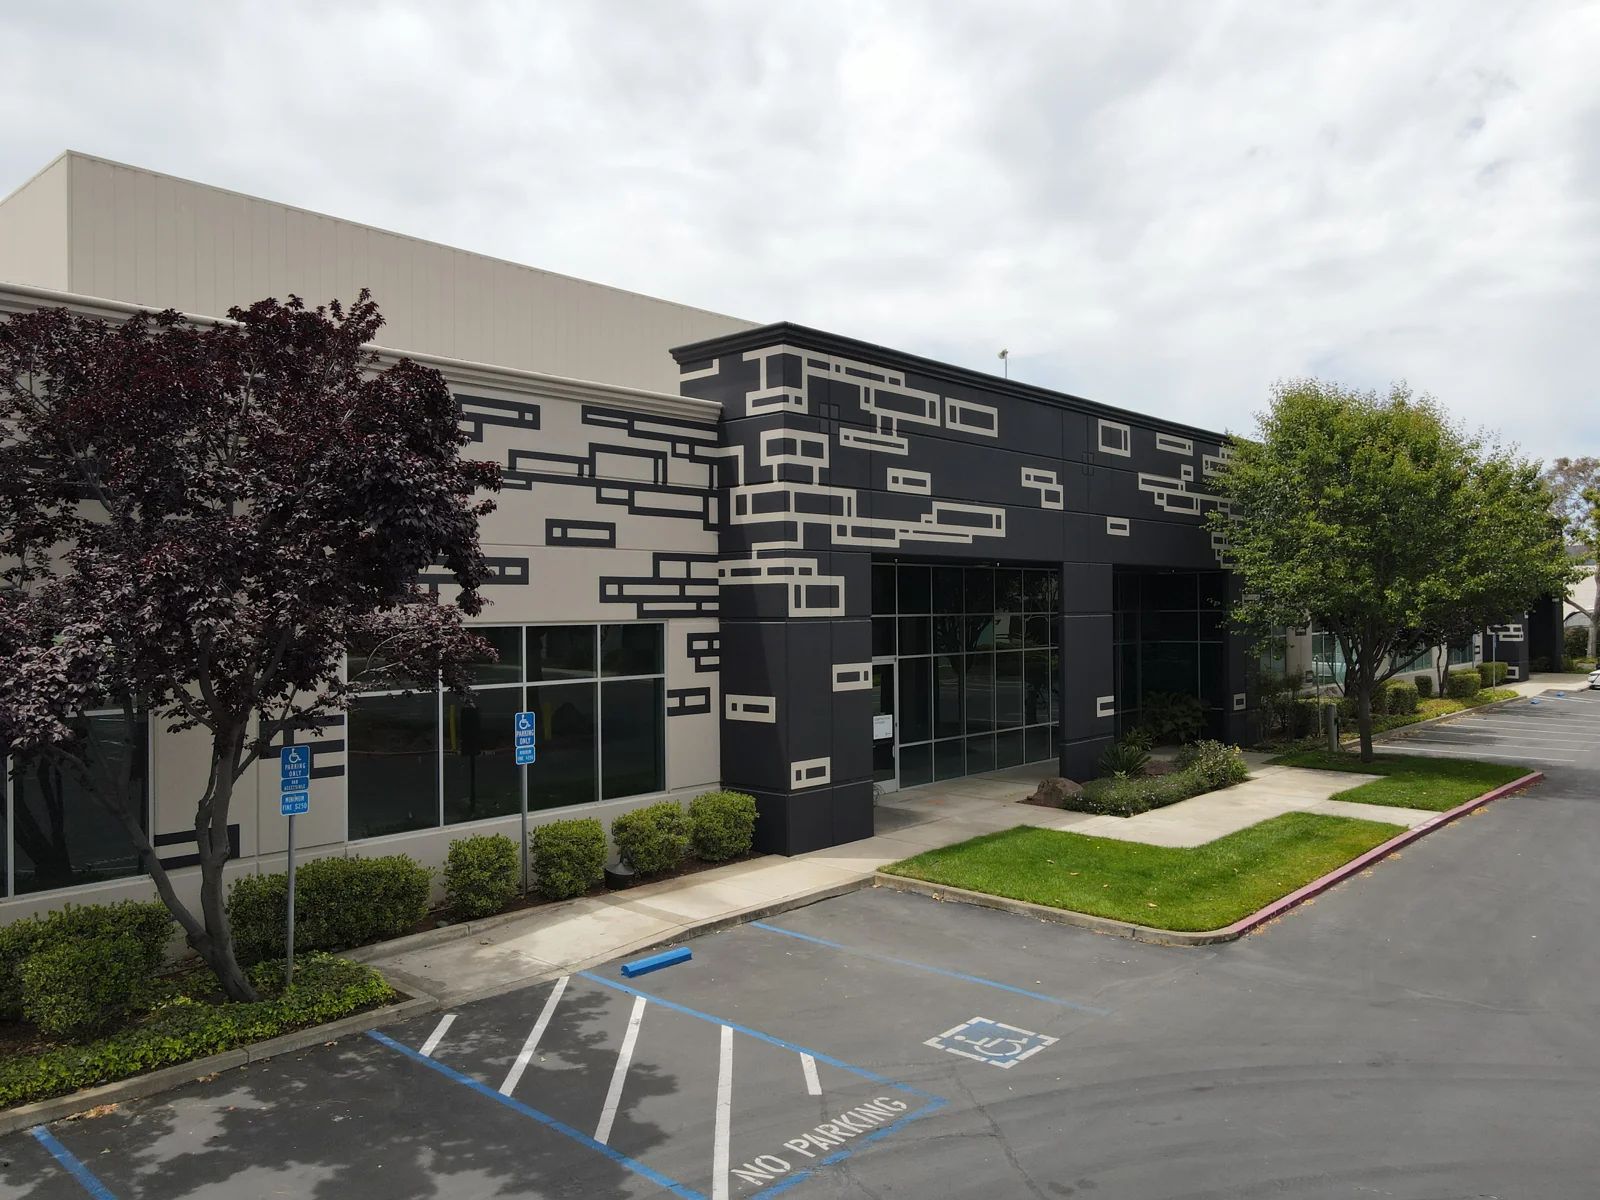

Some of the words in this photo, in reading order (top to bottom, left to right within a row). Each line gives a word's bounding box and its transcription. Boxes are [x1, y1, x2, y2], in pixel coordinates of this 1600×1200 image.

[516, 729, 535, 737] PARKING
[284, 762, 306, 770] PARKING
[294, 802, 308, 810] $250
[730, 1154, 791, 1186] NO
[783, 1096, 908, 1158] PARKING
